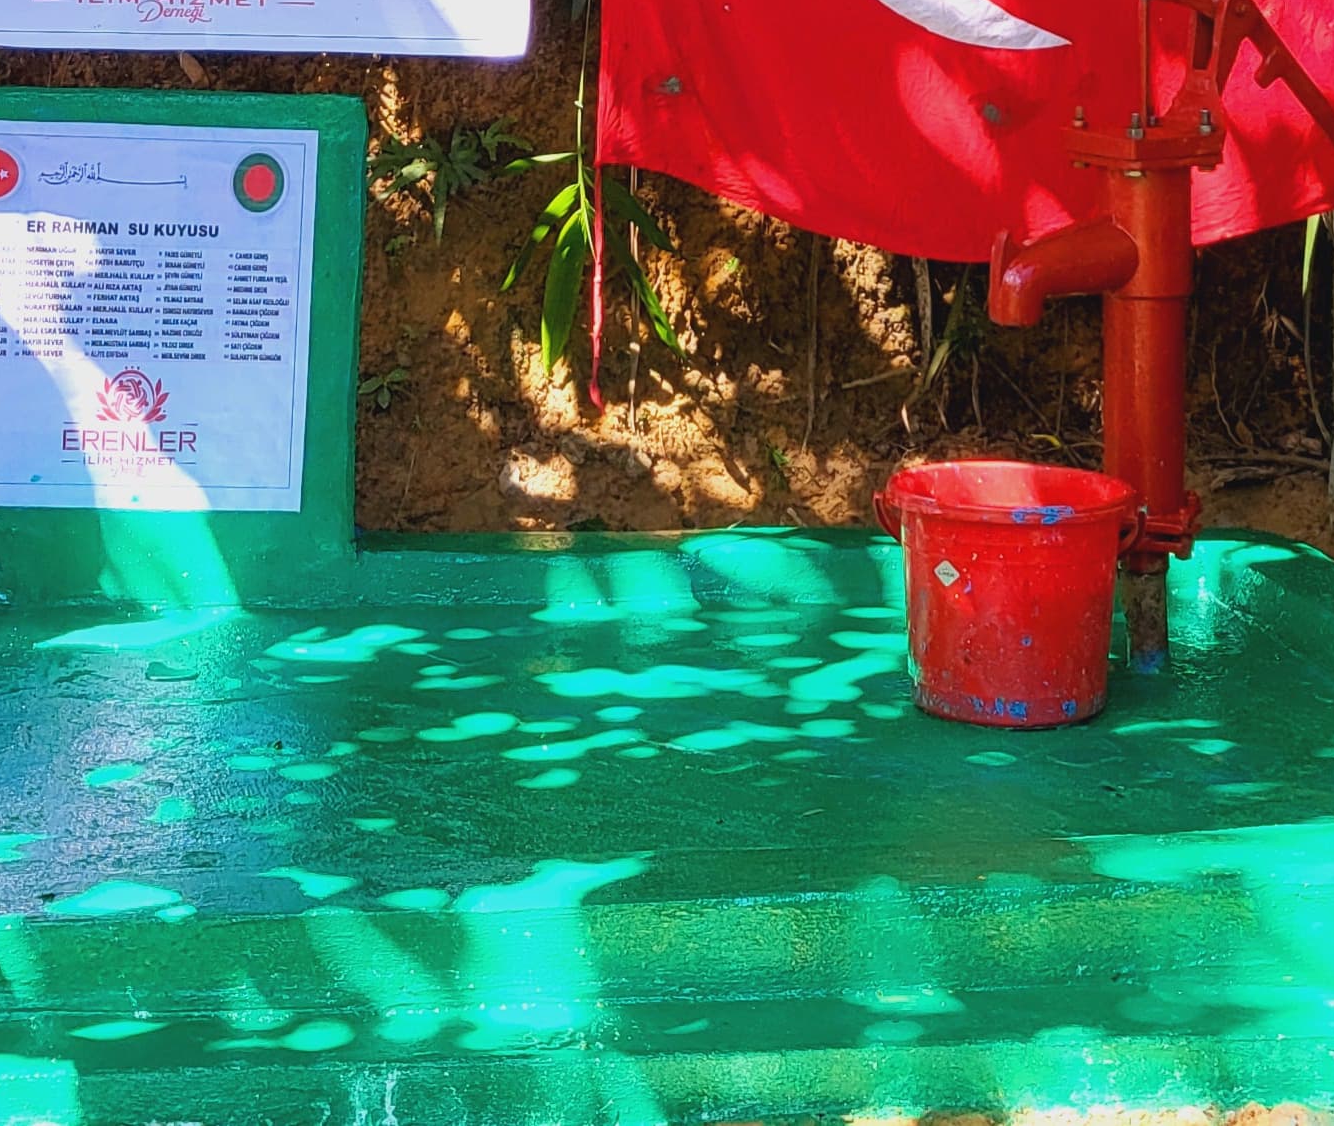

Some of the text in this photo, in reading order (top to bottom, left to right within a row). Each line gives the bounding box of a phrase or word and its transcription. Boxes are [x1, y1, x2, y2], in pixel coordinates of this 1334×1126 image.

[136, 1, 212, 23] Derneği
[27, 221, 219, 237] ER RAHMAN SU KUYUSU
[62, 430, 197, 452] ERENLER
[83, 453, 112, 466] İLİM
